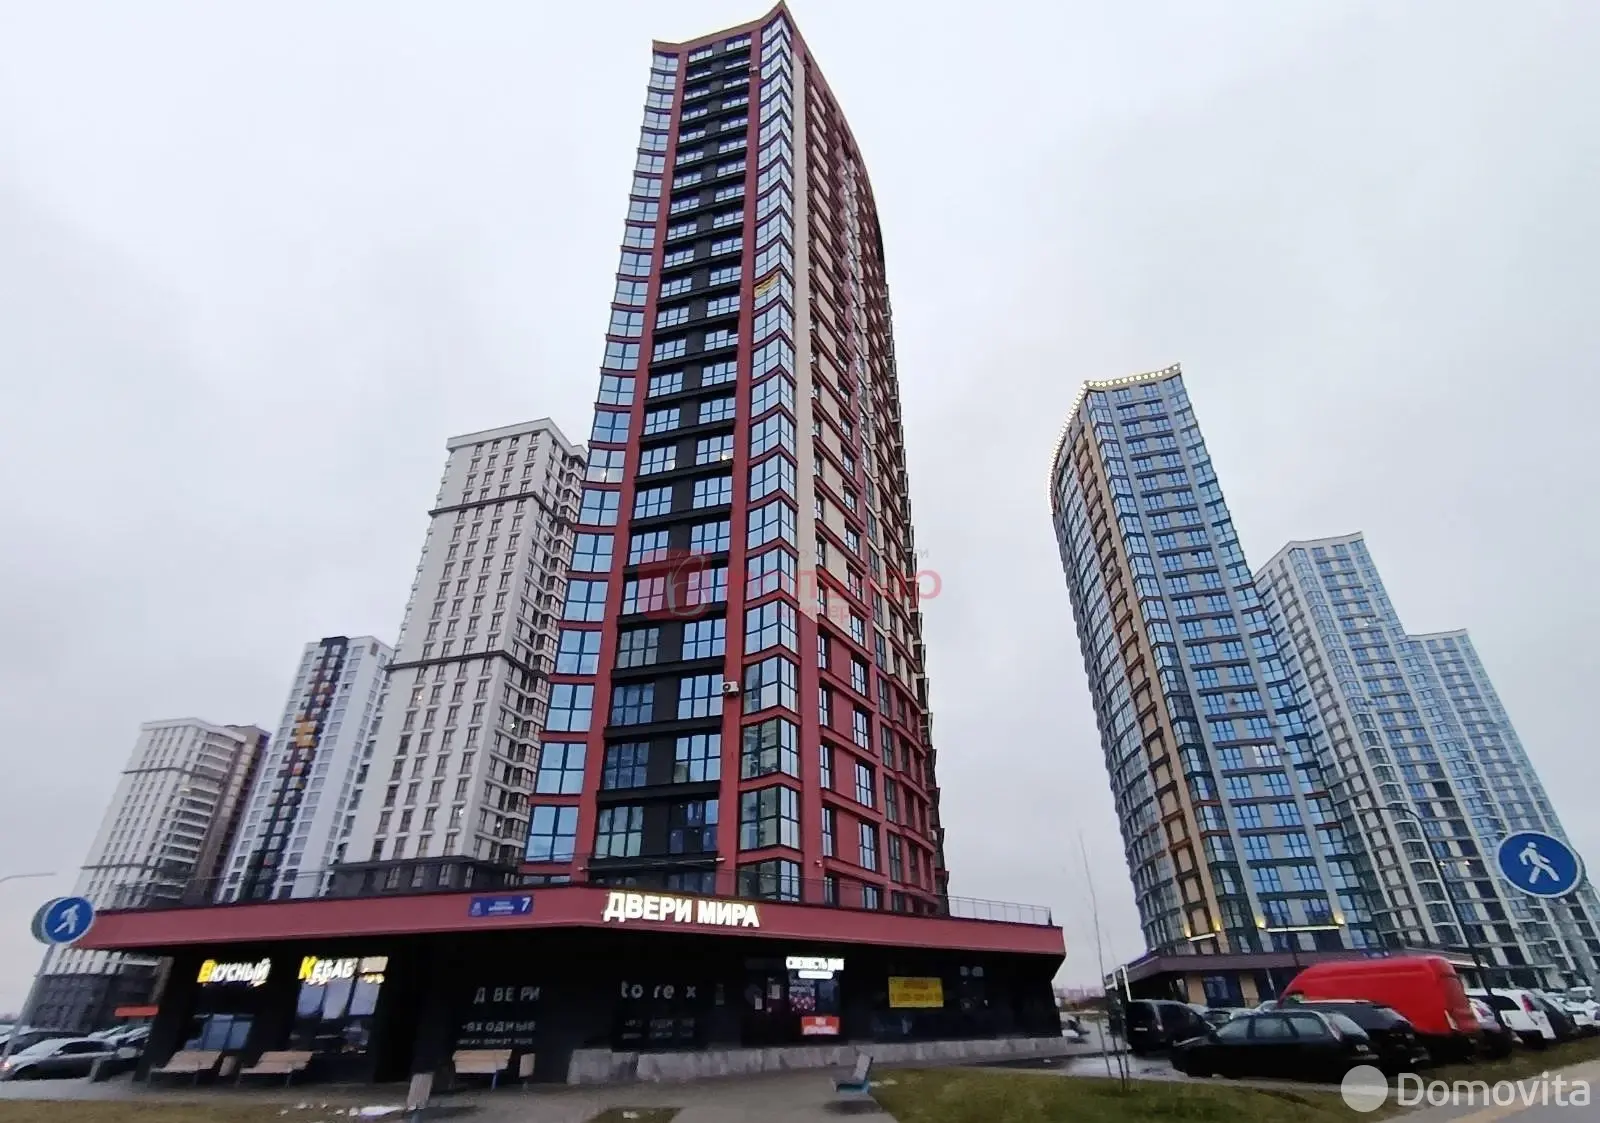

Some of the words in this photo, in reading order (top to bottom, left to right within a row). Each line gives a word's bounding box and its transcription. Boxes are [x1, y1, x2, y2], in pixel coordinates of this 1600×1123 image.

[521, 897, 532, 912] 7
[603, 892, 692, 923] ДВЕРИ
[697, 899, 760, 927] МИРА
[473, 985, 541, 1005] ДВЕРИ
[620, 979, 697, 1000] torex
